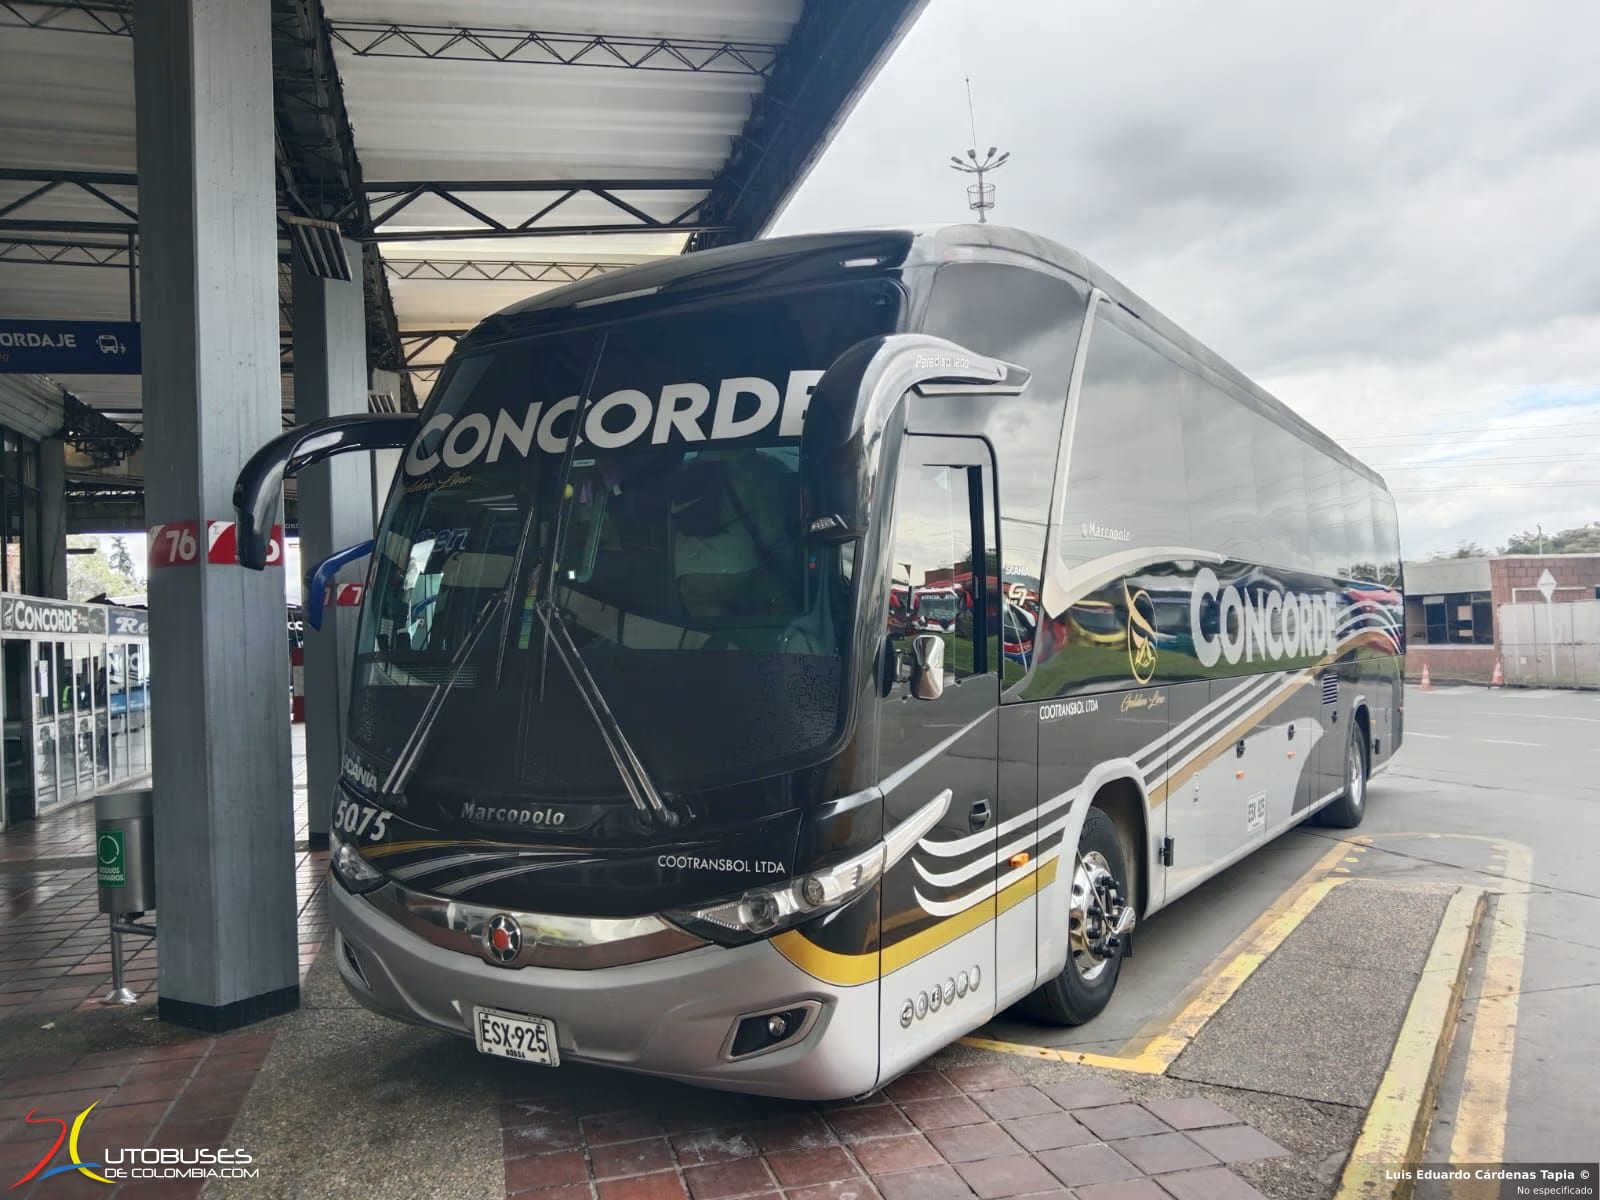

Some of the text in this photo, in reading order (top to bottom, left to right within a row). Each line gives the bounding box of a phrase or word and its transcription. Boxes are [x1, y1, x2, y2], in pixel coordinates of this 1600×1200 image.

[404, 369, 828, 477] CONCORDE
[166, 529, 197, 563] 76
[15, 600, 78, 633] CONCORDE
[1190, 567, 1338, 668] CONCORDE
[1040, 699, 1099, 720] COOTRANSBOL LTDA
[334, 799, 393, 841] 5075
[460, 801, 565, 826] Marcopolo
[657, 855, 787, 874] COOTRANSBOL LTDA
